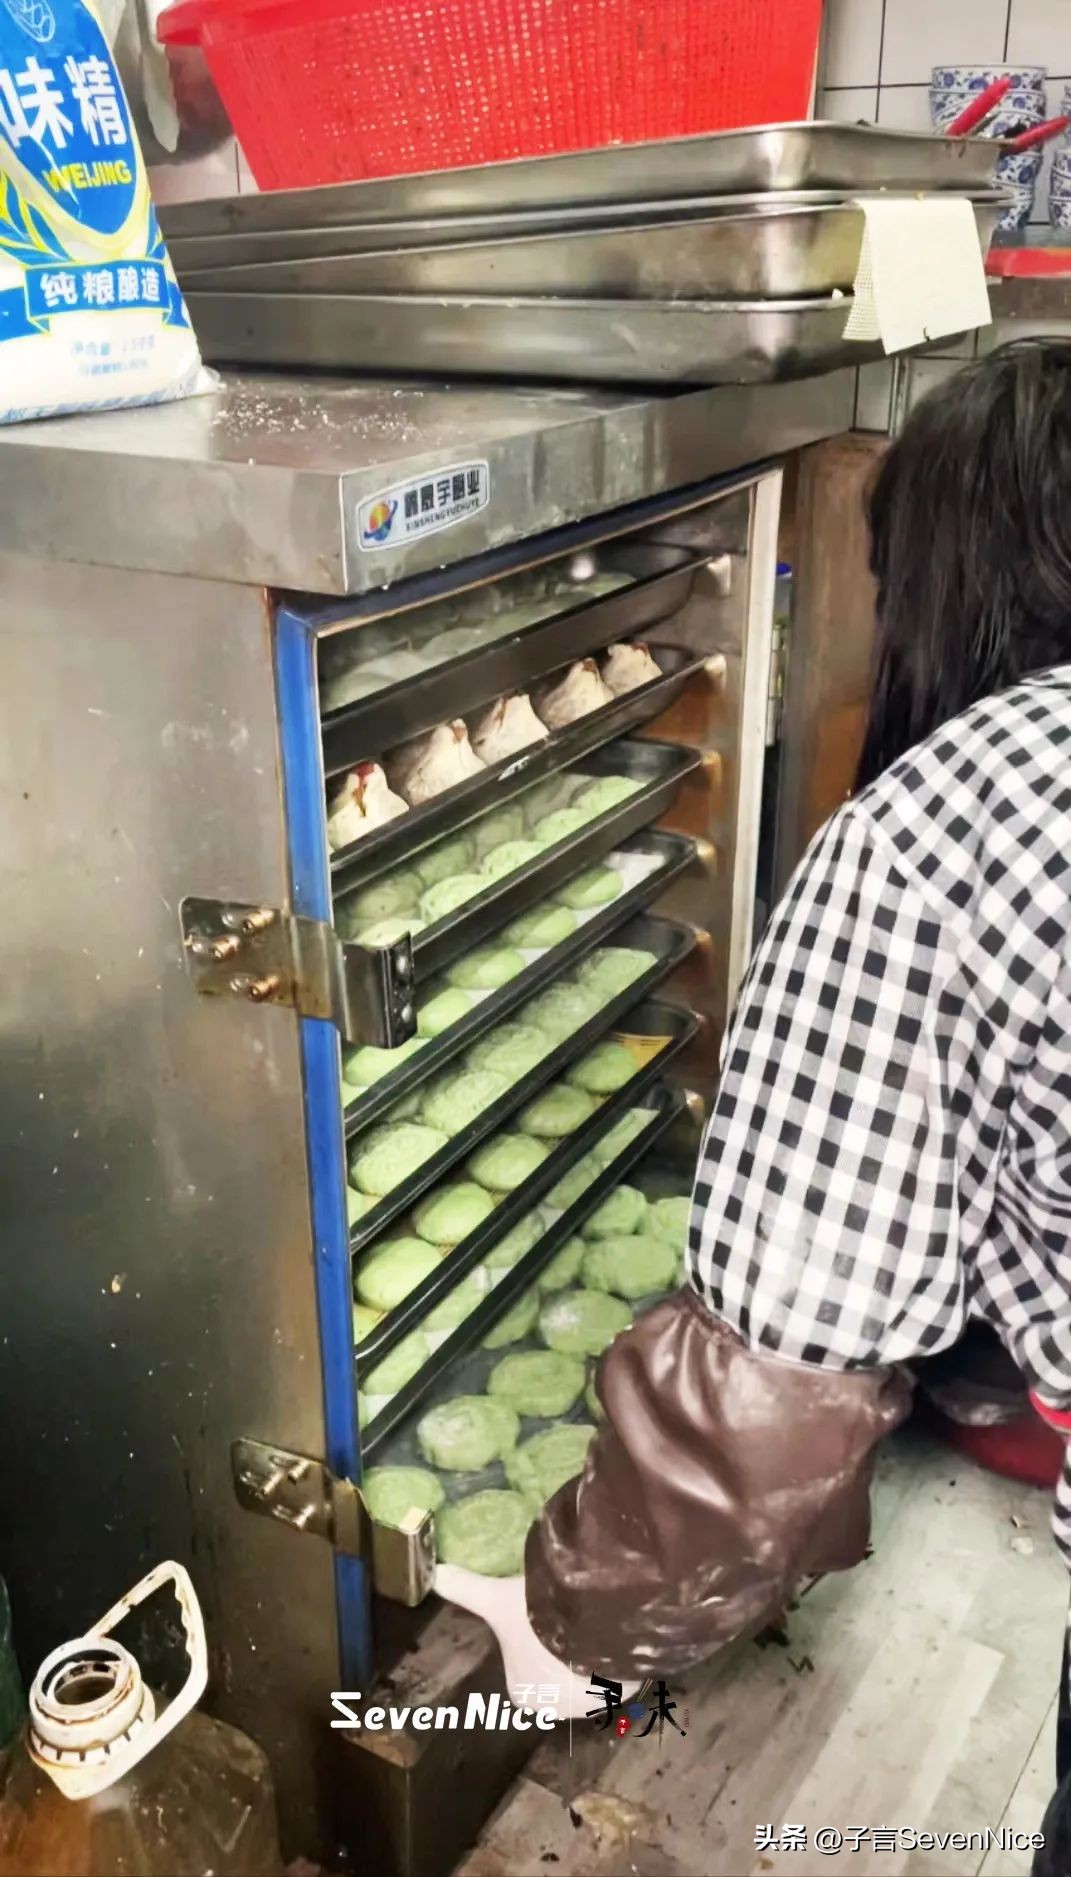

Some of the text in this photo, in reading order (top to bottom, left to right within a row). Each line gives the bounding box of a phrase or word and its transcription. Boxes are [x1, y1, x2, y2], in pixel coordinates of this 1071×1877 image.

[0, 55, 127, 150] 味精
[42, 159, 132, 192] WEIJING
[40, 266, 160, 307] 纯粮酿造
